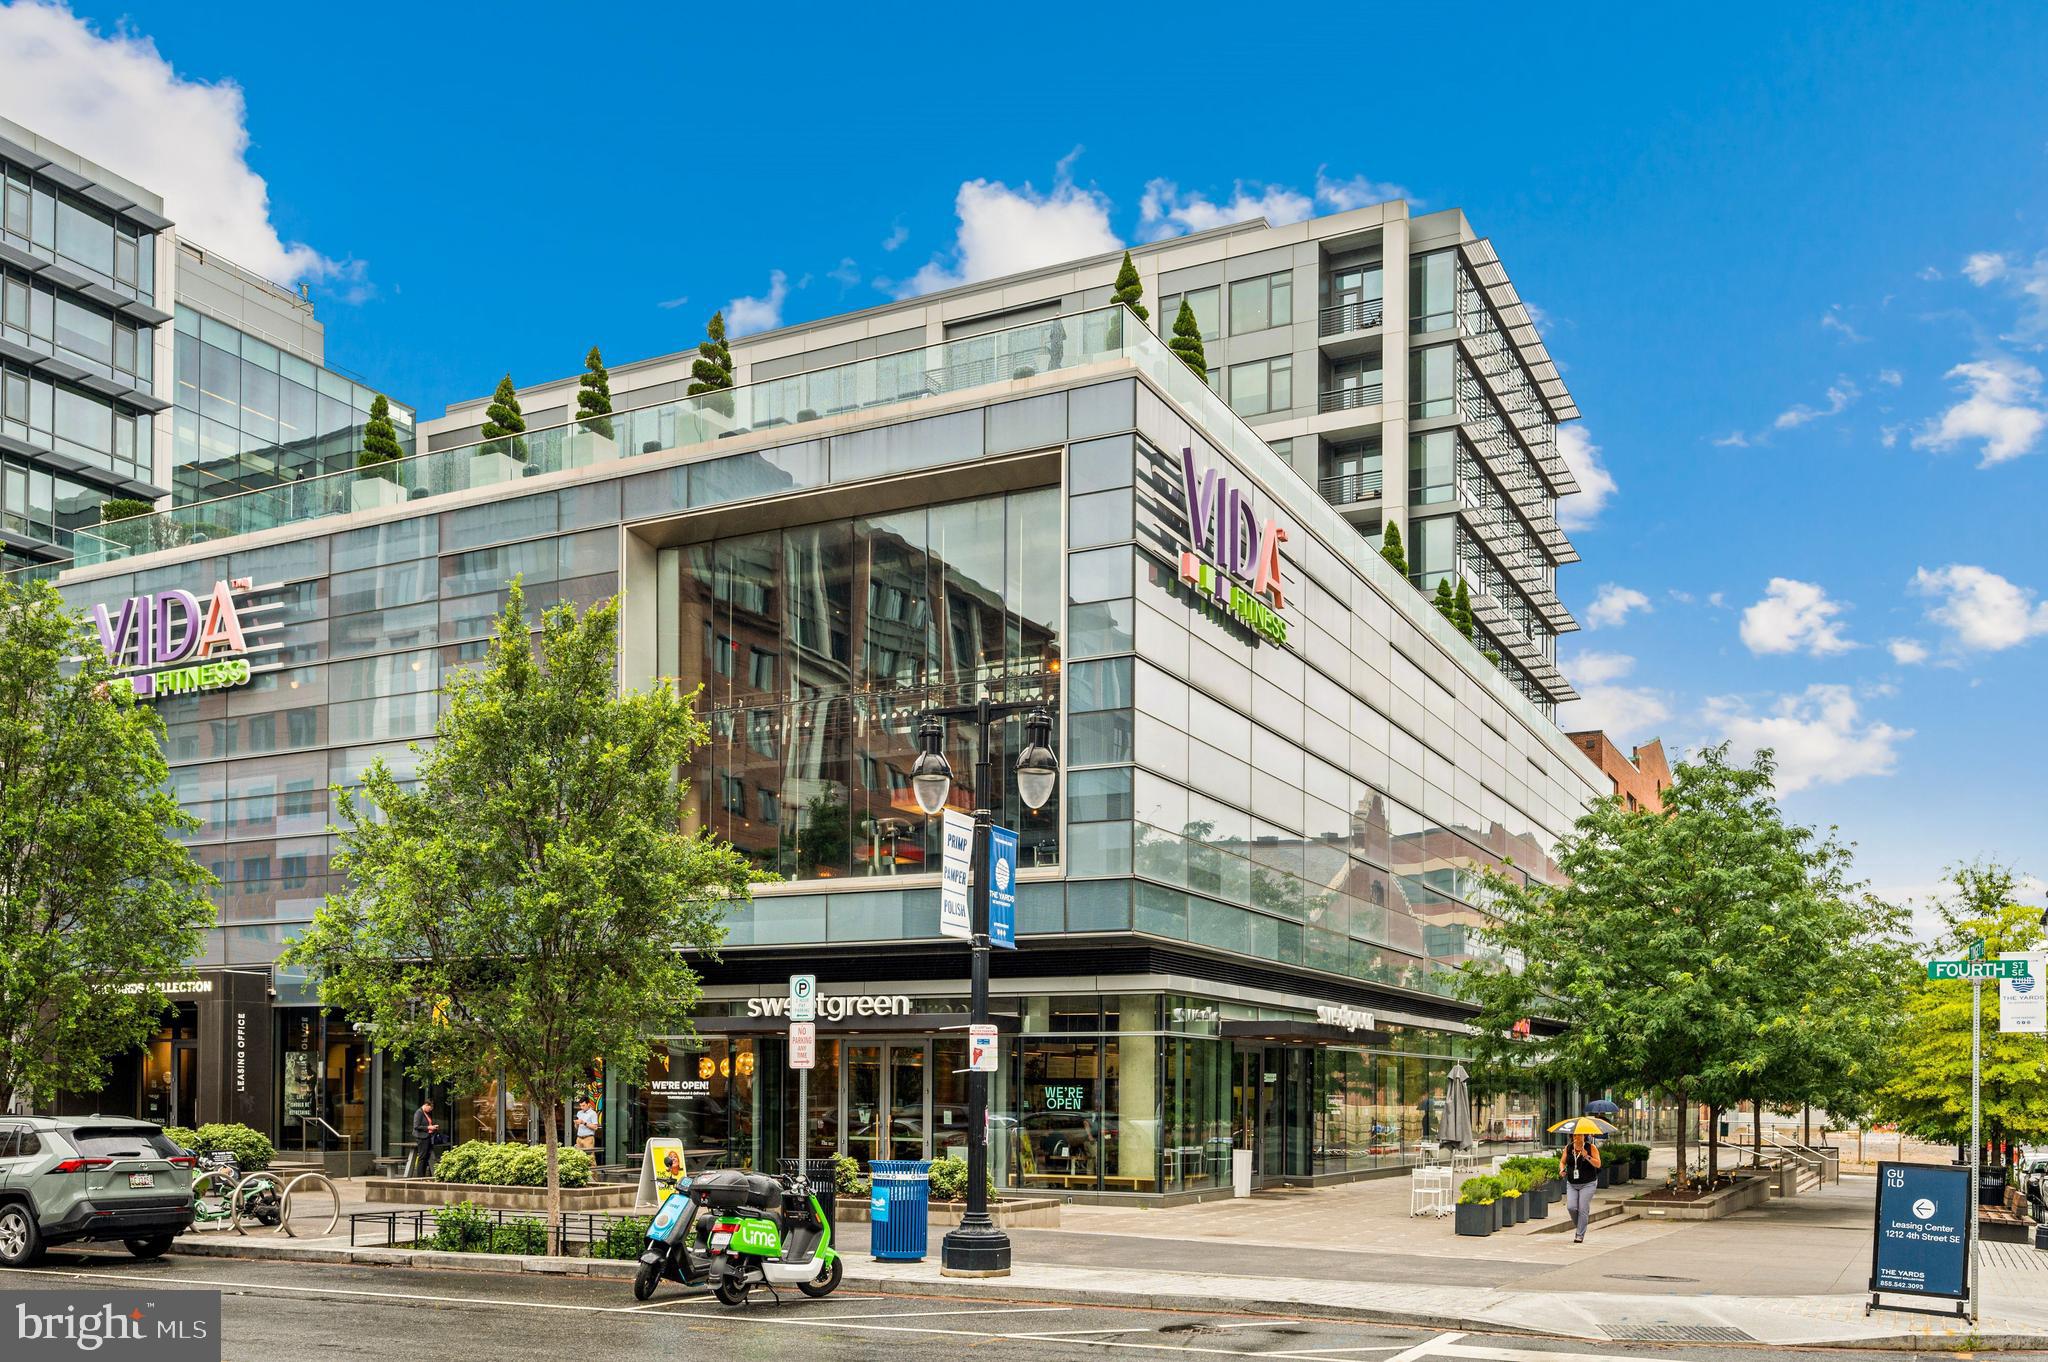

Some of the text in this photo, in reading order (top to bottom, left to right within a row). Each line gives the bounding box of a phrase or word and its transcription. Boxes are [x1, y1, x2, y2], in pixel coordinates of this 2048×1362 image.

[1182, 446, 1286, 609] VIDA
[1229, 586, 1287, 645] FITNESS
[94, 580, 248, 666] VIDA
[155, 659, 250, 694] FITNESS
[947, 833, 968, 852] PRIMP
[944, 865, 967, 887] PAMPER
[944, 899, 967, 918] POLISH
[1936, 963, 2006, 977] FOURTH
[2012, 961, 2025, 969] ST
[2012, 969, 2025, 977] SE
[747, 992, 910, 1022] swtgreen
[798, 1027, 807, 1036] NO
[792, 1036, 812, 1045] PARKING
[237, 1013, 245, 1092] LEASING OFFICE
[651, 1081, 709, 1090] WE'RE OPEN!
[1046, 1097, 1081, 1110] OPEN
[1887, 1169, 1904, 1178] GU
[1887, 1178, 1904, 1188] ILD
[1892, 1220, 1954, 1233] Leasing Center
[1885, 1230, 1961, 1243] 1212 4th Street SE
[1898, 1270, 1925, 1278] YARDS
[1880, 1280, 1924, 1290] 855.542.3093
